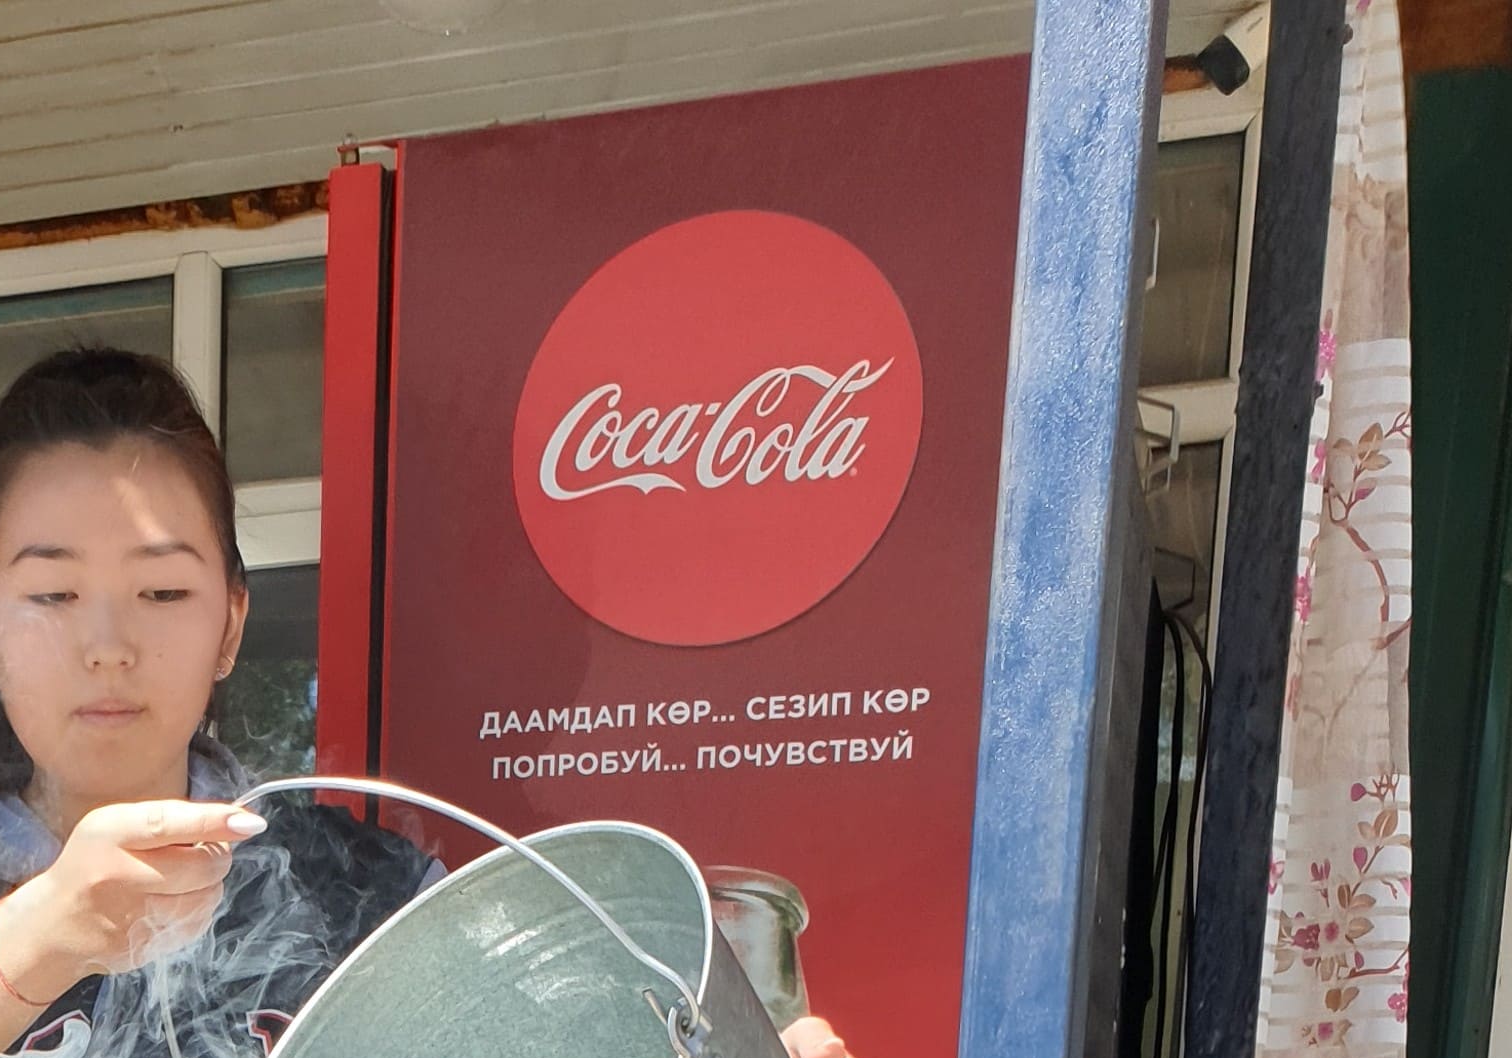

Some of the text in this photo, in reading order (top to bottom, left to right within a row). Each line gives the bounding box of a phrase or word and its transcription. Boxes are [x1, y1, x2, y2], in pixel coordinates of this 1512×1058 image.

[540, 356, 895, 500] Coca-Cola
[479, 703, 636, 740] ДААМДАП
[745, 691, 851, 722] СЕЗИП
[863, 687, 930, 716] КӨР
[492, 728, 914, 781] ПОПРОБУЙ... ПОЧУВСТВУЙ
